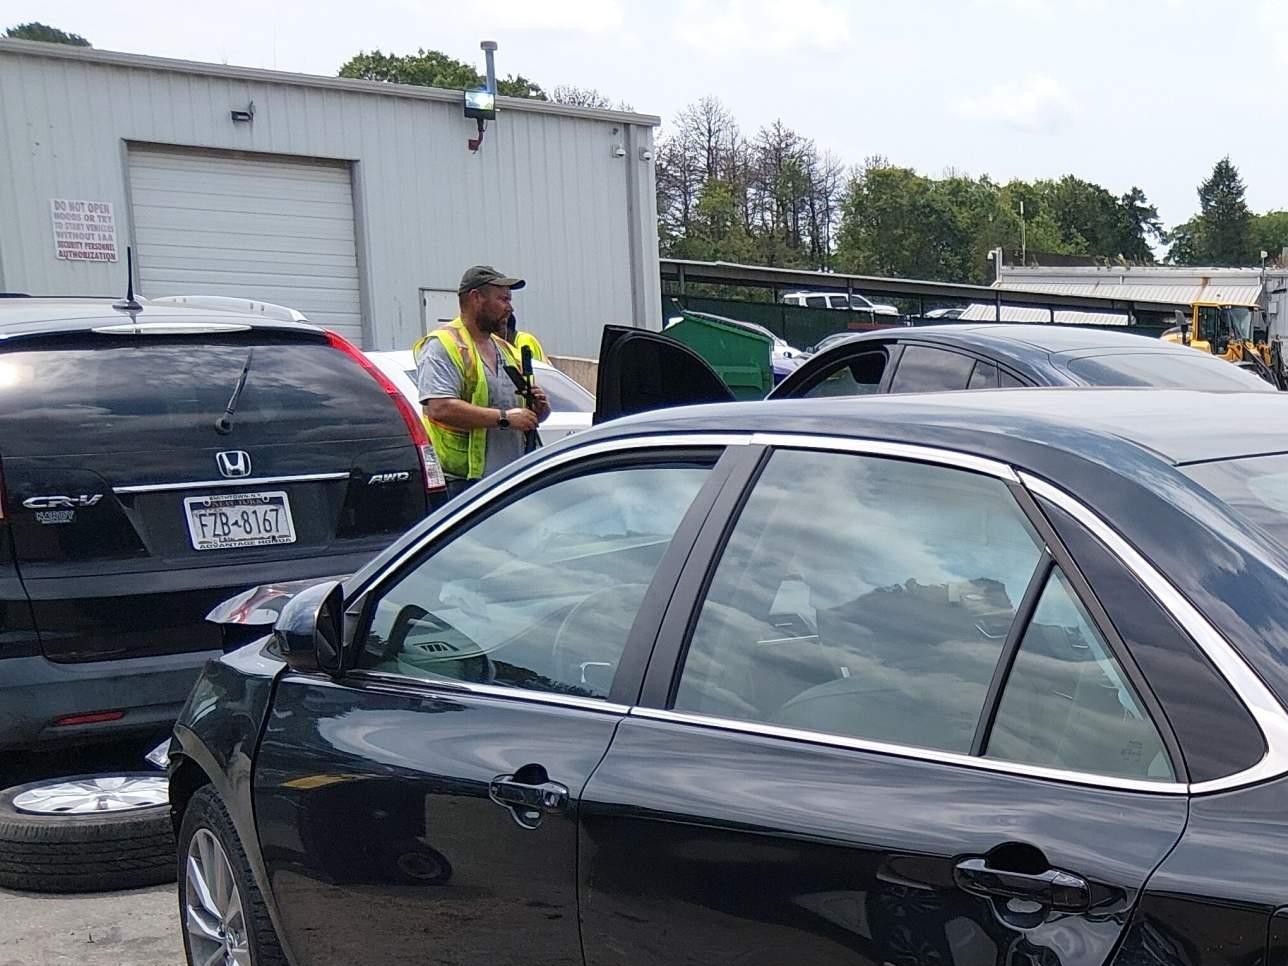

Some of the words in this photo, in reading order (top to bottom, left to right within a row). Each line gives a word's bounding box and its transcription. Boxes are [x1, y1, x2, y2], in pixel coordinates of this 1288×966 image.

[54, 200, 66, 211] DO
[68, 201, 85, 213] NOT
[87, 202, 110, 215] OPEN
[84, 214, 95, 222] OR
[97, 214, 112, 223] TRY
[86, 223, 114, 233] VEHICLES
[56, 231, 95, 241] WITHOUT
[57, 240, 83, 249] SECURITY
[84, 242, 115, 251] PERSONNEL
[58, 249, 116, 260] AUTHORIZATION
[367, 471, 410, 485] AWD
[22, 494, 104, 509] CR-V
[199, 541, 256, 549] ADVANTAGE
[257, 537, 292, 545] HONDA
